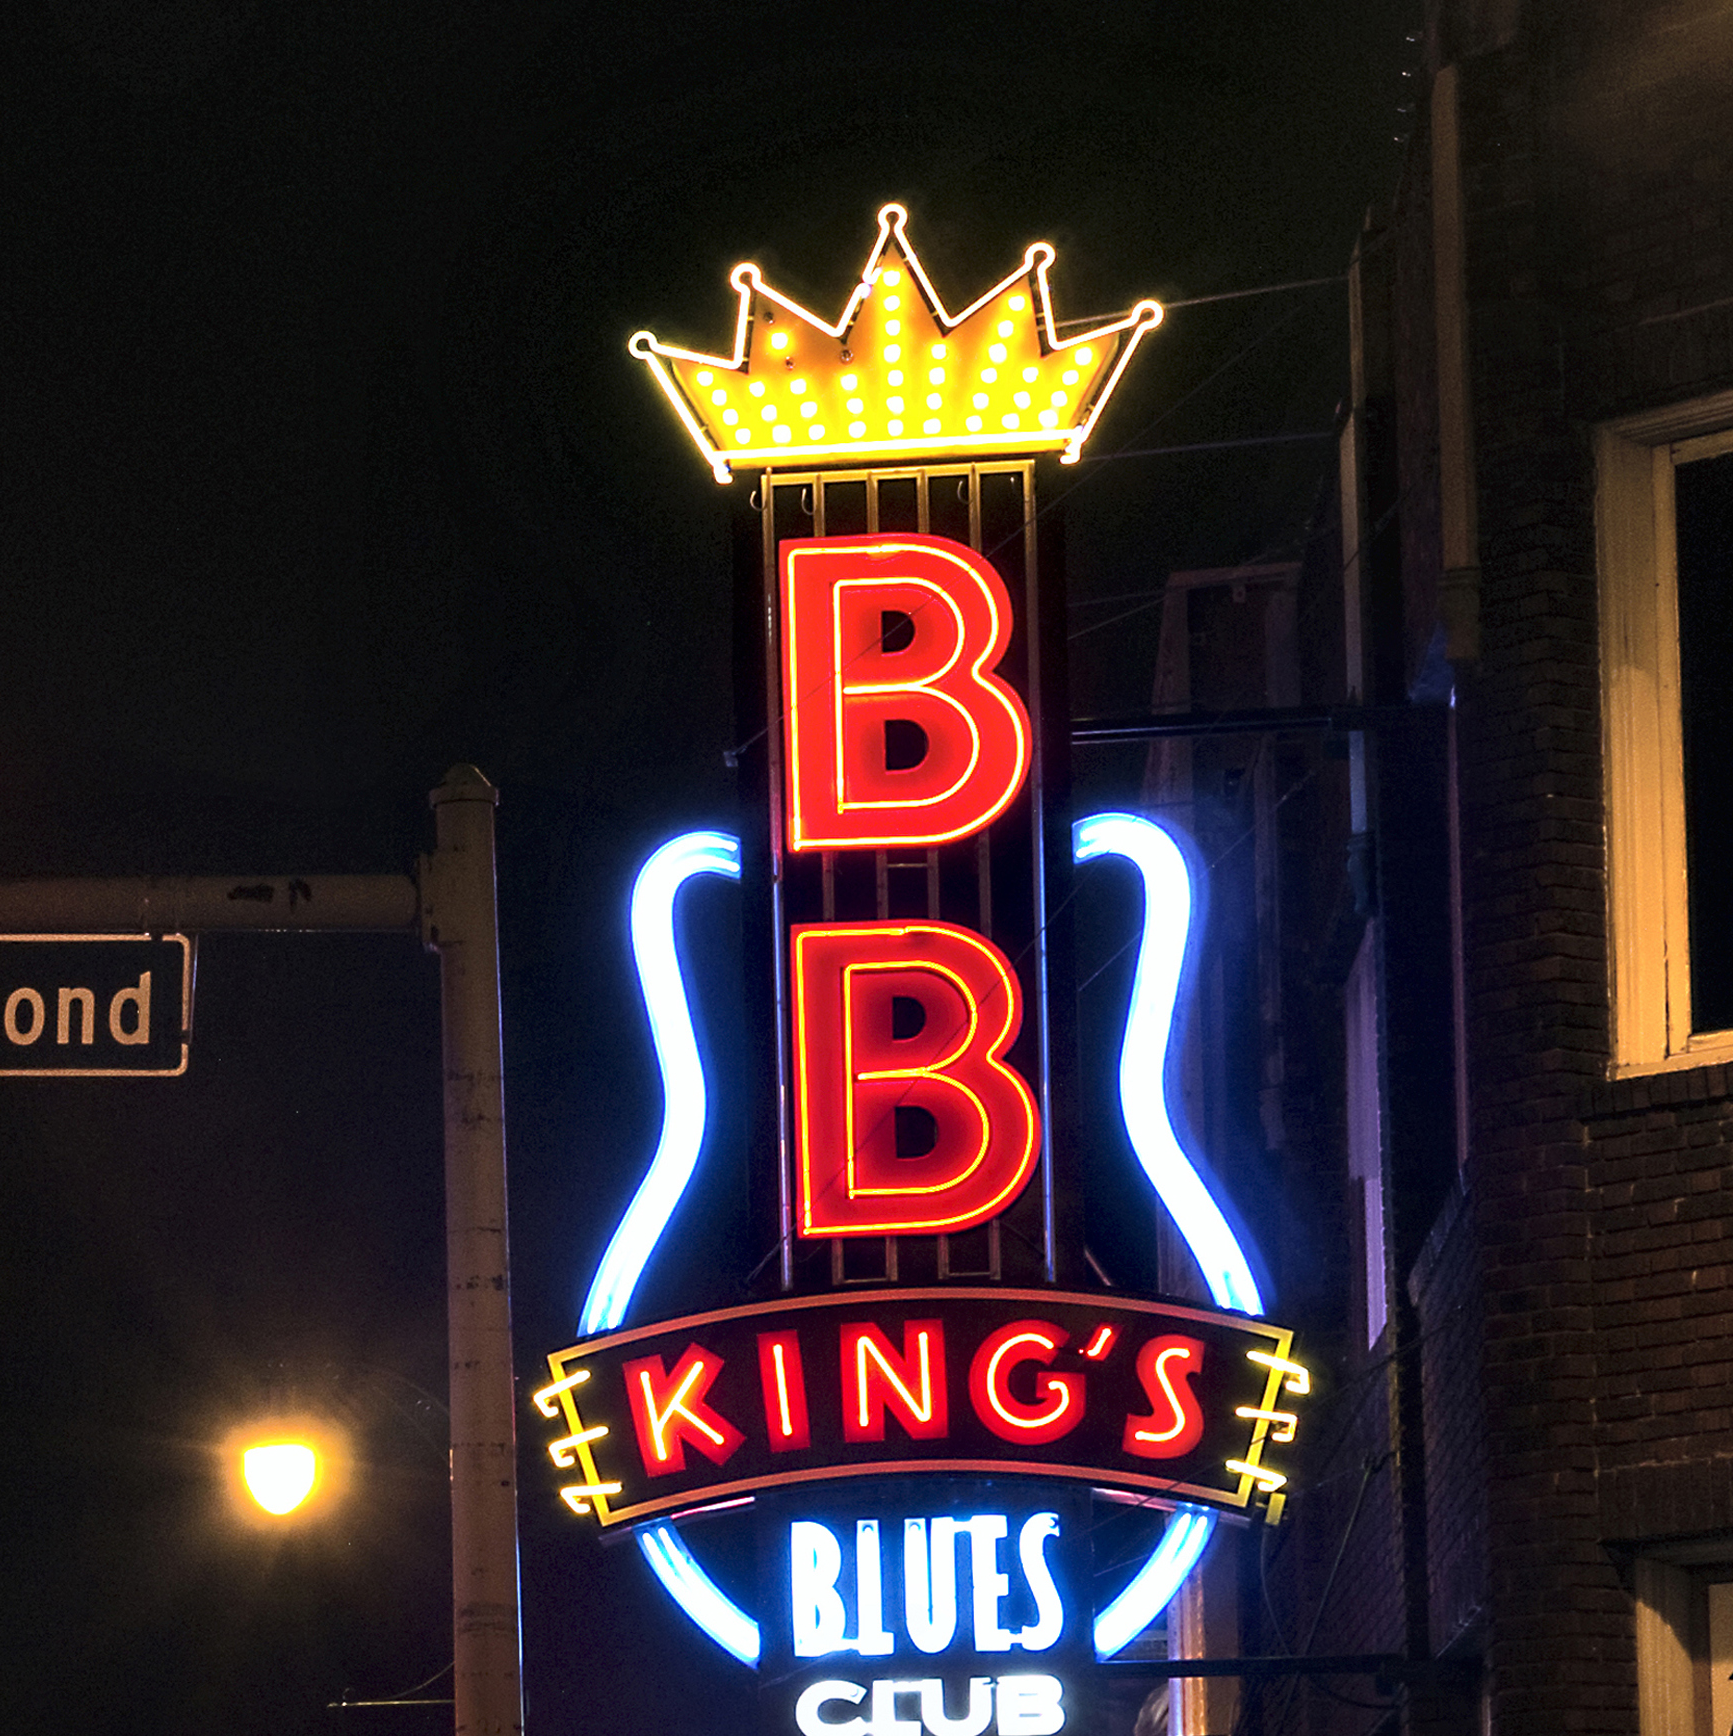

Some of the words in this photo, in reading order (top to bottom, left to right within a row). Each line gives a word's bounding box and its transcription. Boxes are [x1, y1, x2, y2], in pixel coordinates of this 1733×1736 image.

[778, 533, 1032, 851] B
[790, 921, 1042, 1239] B
[622, 1319, 1208, 1479] KING'S
[790, 1512, 1066, 1659] BLUES
